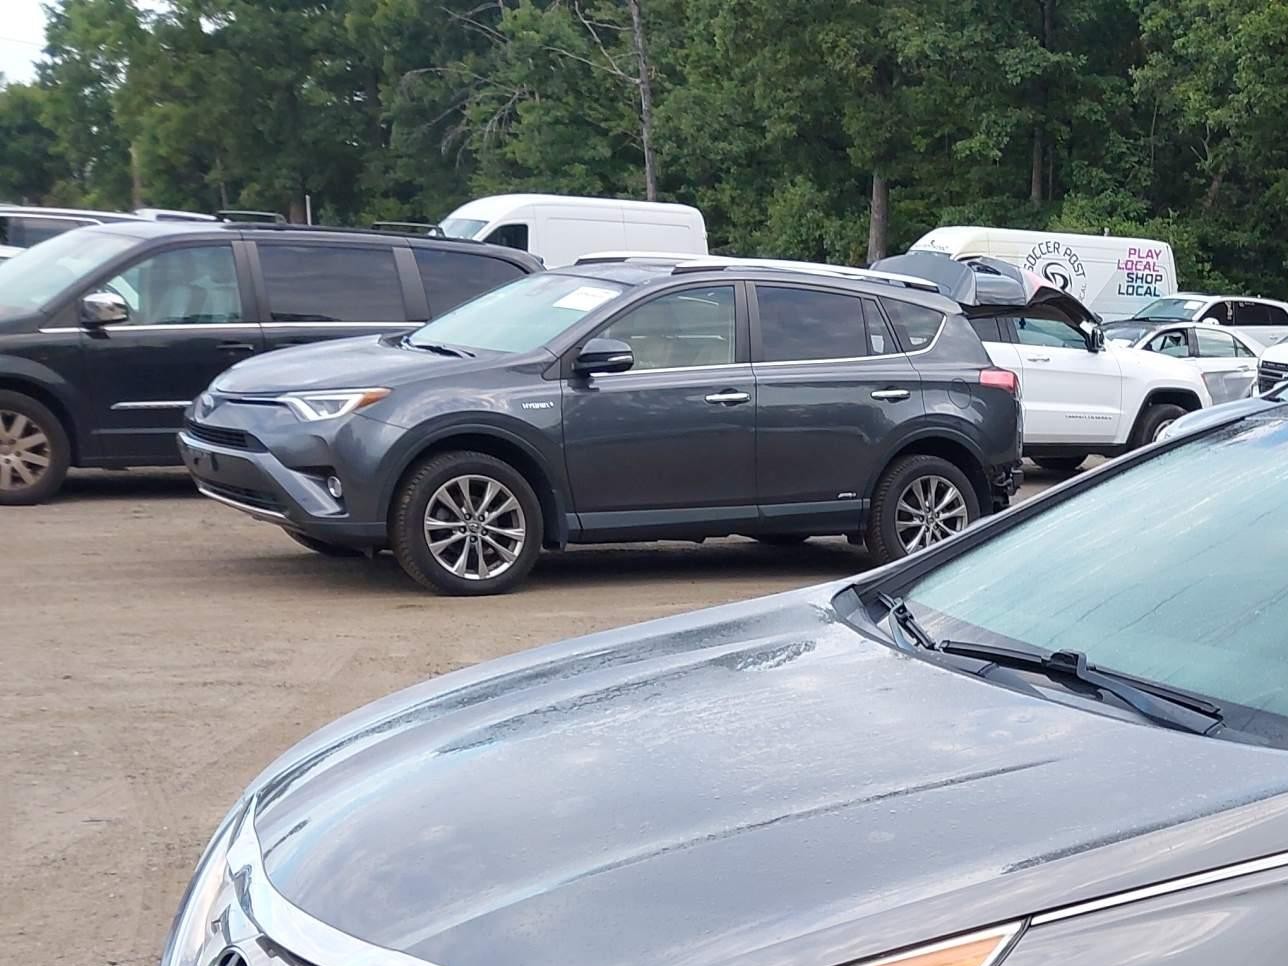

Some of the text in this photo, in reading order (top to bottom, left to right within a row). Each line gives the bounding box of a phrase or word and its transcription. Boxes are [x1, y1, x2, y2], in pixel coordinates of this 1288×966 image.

[1024, 241, 1086, 278] SOCCER POST
[1128, 247, 1162, 260] PLAY
[1117, 259, 1160, 272] LOCAL
[1126, 272, 1163, 285] SHOP
[1118, 283, 1161, 298] LOCAL
